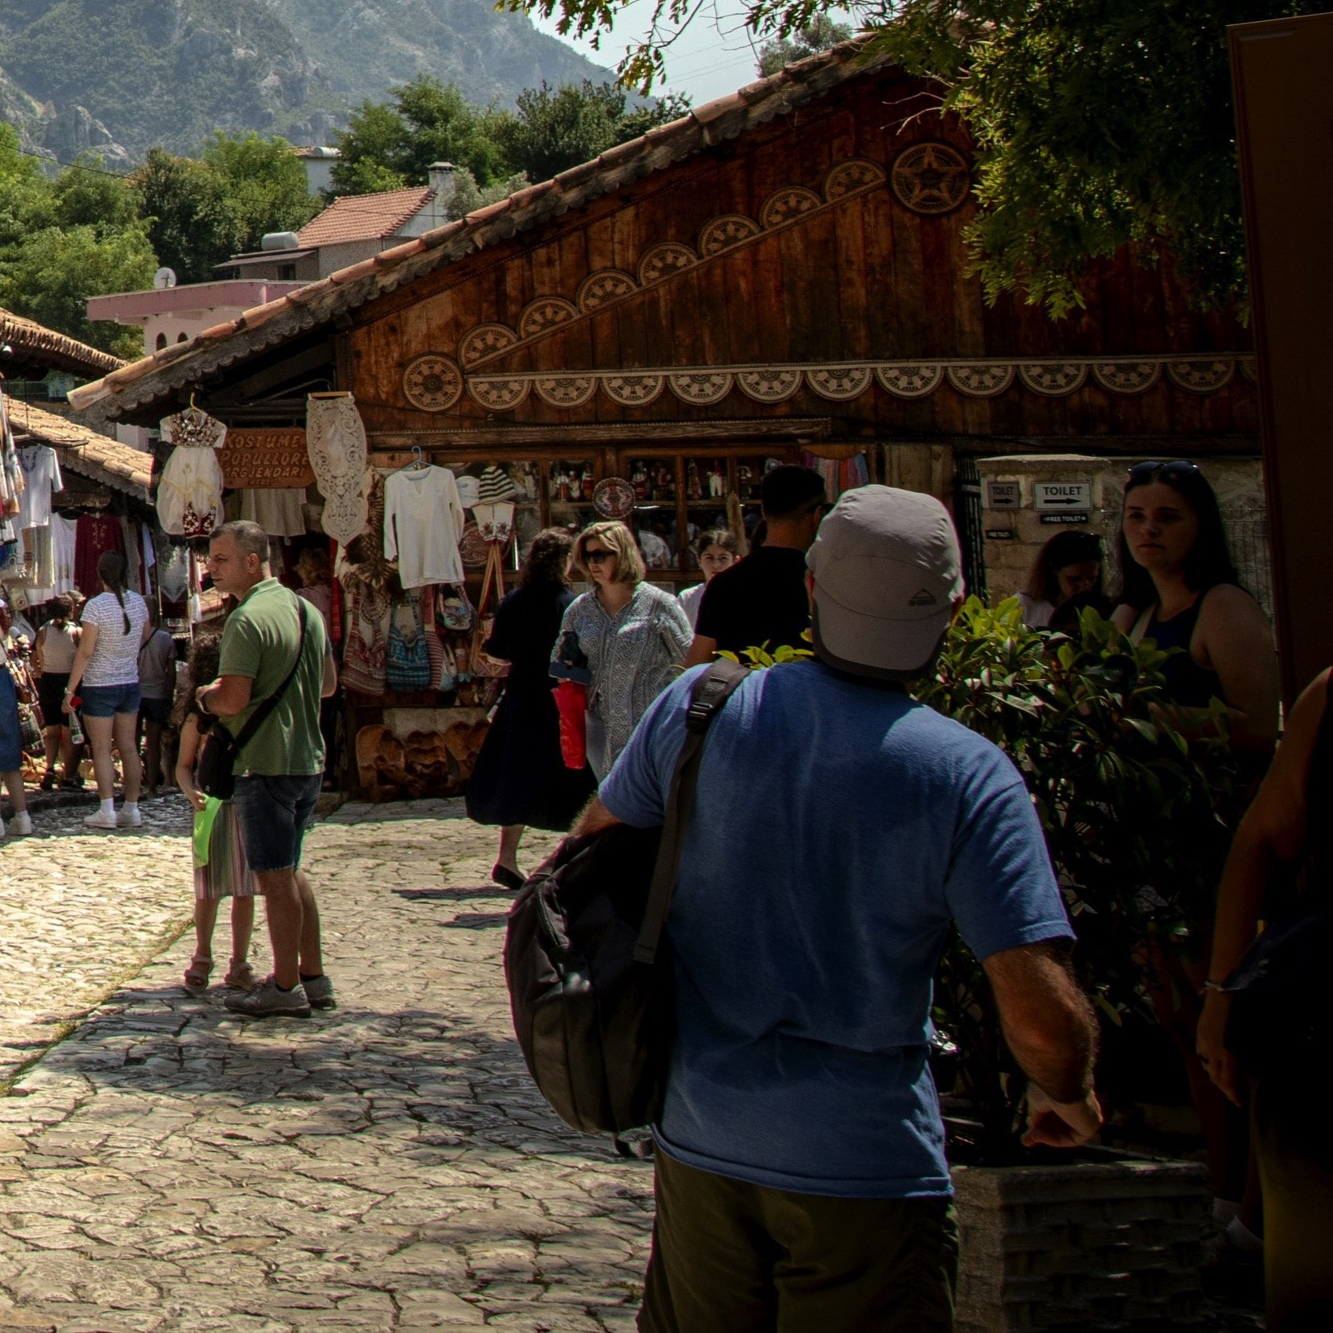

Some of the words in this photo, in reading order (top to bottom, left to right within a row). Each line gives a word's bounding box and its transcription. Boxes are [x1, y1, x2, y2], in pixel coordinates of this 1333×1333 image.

[226, 434, 300, 448] KOSTUME
[221, 450, 309, 465] POPULLORE
[225, 467, 304, 478] ARGJENDARI
[992, 486, 1014, 495] TOILET
[1043, 486, 1082, 495] TOILET
